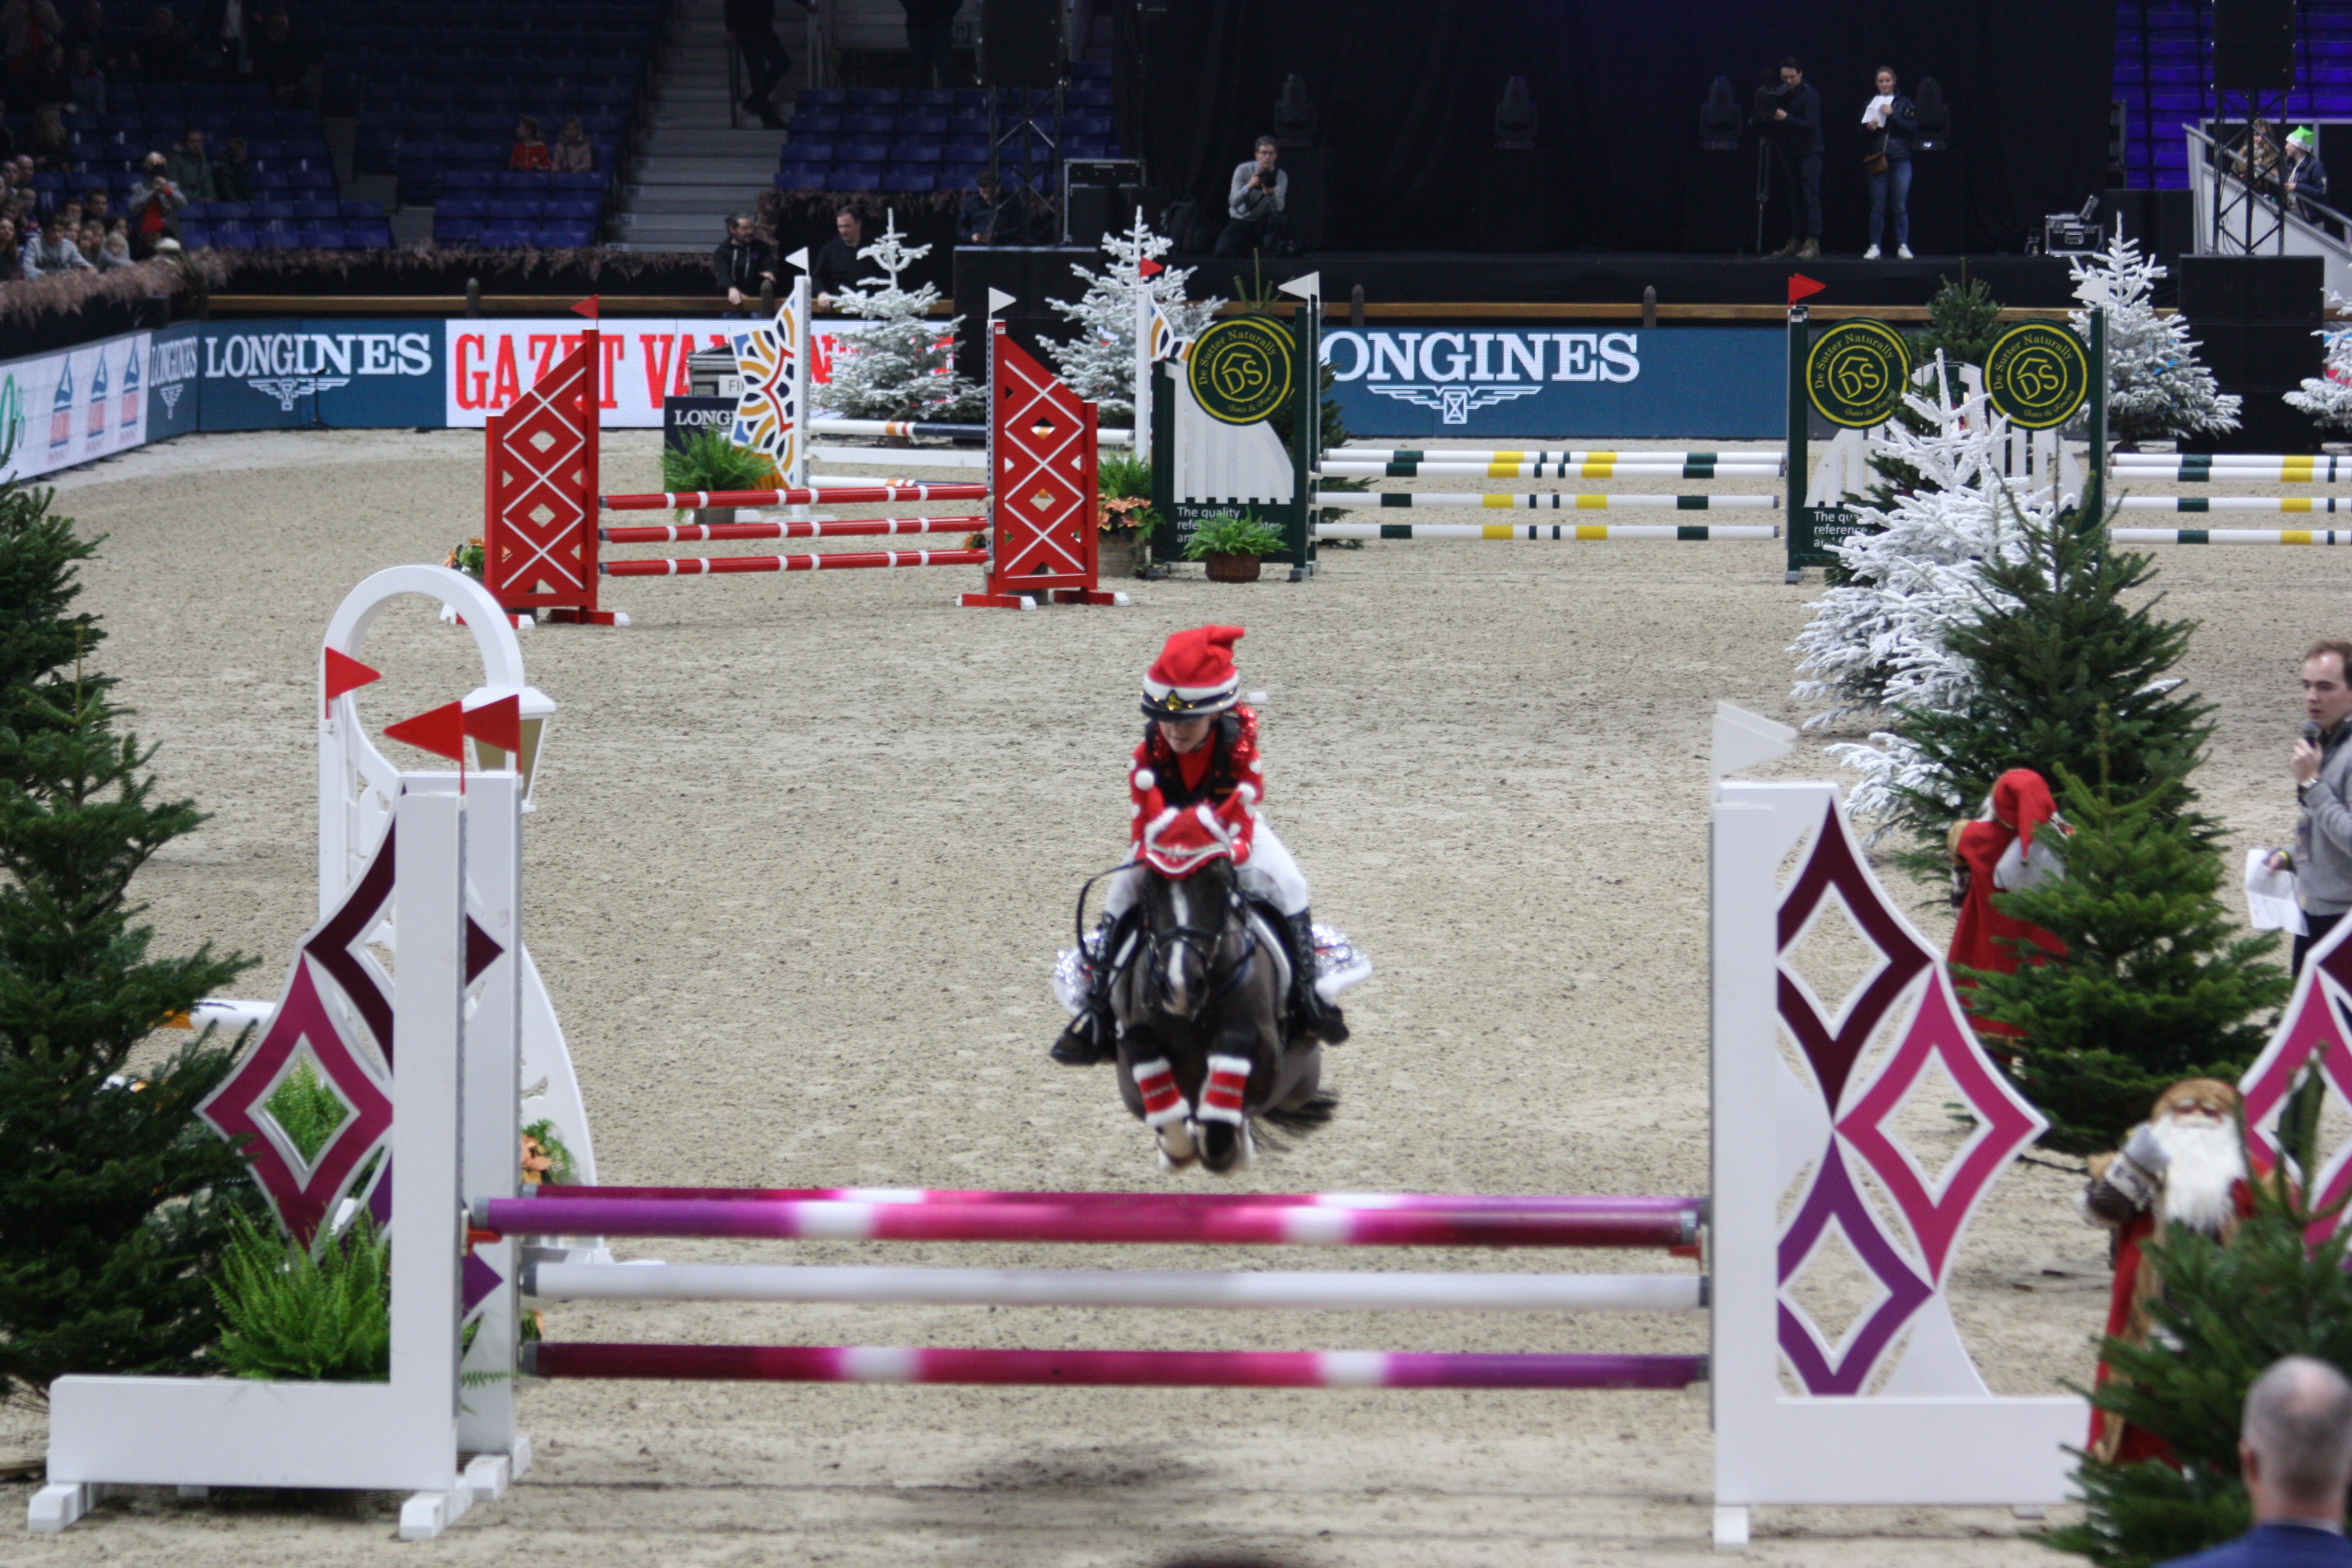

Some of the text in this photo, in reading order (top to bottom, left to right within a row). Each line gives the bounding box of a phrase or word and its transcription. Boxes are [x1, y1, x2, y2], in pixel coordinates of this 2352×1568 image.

[205, 333, 432, 377] LONGINES
[1199, 329, 1277, 385] De Sutter Naturally
[1319, 331, 1641, 383] ONGINES
[1815, 333, 1894, 389] De Sutter Naturally
[1994, 334, 2074, 390] De Sutter Naturally
[1177, 507, 1241, 519] The quality
[1813, 511, 1836, 522] The
